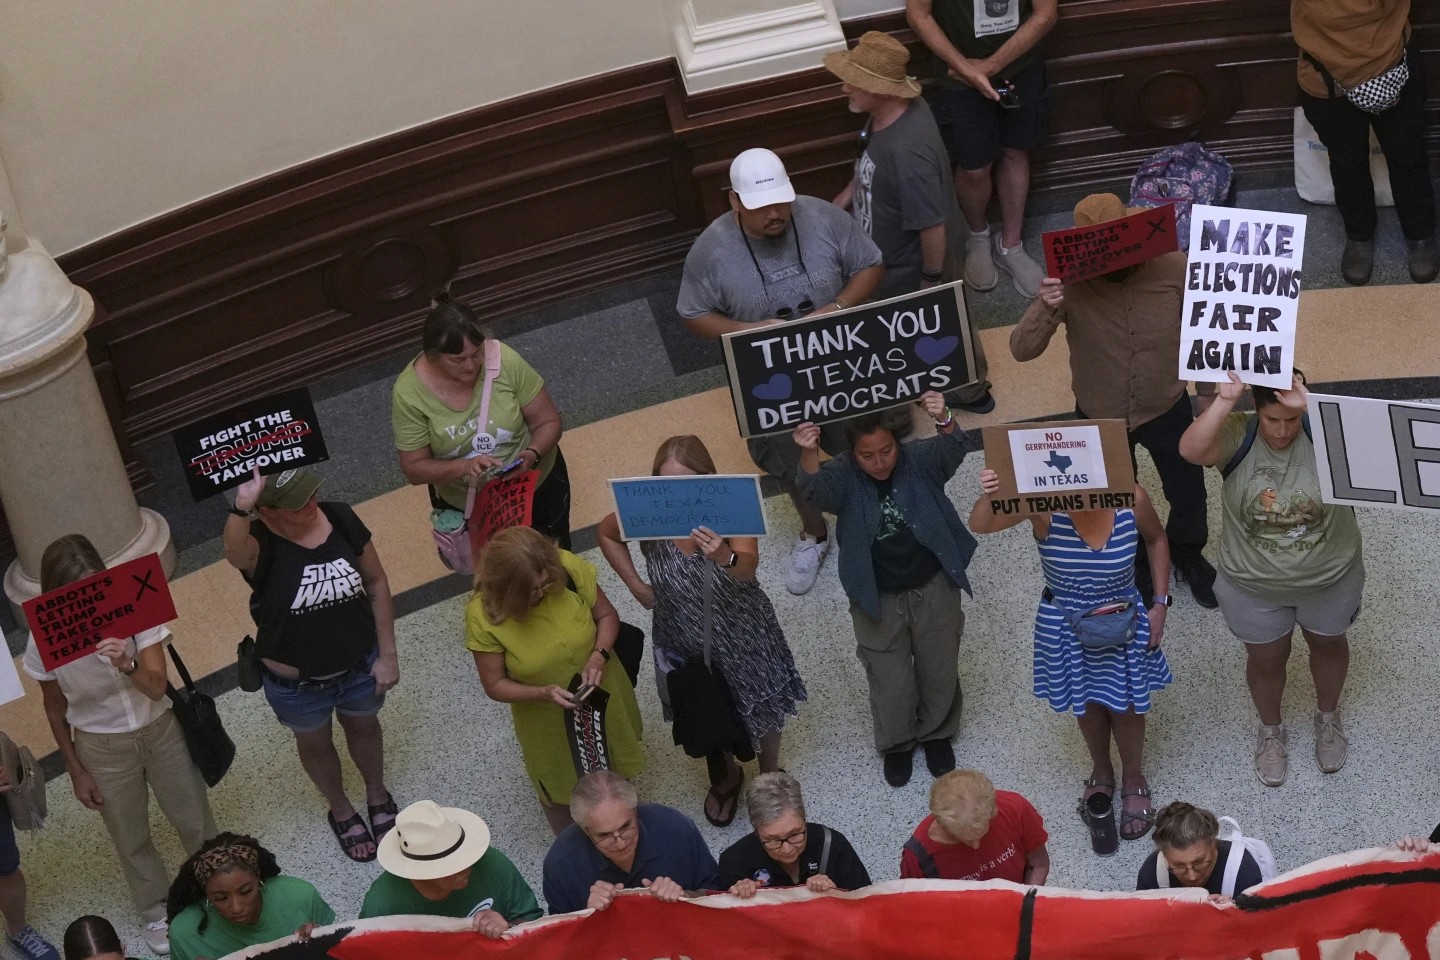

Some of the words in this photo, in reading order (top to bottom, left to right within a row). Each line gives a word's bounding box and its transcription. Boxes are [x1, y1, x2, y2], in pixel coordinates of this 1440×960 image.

[1200, 219, 1295, 259] MAKE
[1188, 262, 1301, 300] ELECTIONS
[1190, 301, 1282, 333] FAIR
[750, 320, 866, 369] THANK
[877, 304, 942, 343] YOU
[797, 348, 908, 391] TEXAS
[1187, 339, 1283, 375] AGAIN
[757, 365, 952, 430] DEMOCRATS
[199, 420, 252, 451] FIGHT
[254, 409, 293, 430] THE
[477, 436, 490, 444] NO
[1045, 432, 1063, 442] NO
[191, 420, 310, 476] TRUMP
[476, 443, 493, 451] ICE
[1025, 440, 1087, 452] GERRYMANDERING
[209, 446, 306, 486] TAKEOVER
[1034, 476, 1047, 487] IN
[1050, 473, 1089, 487] TEXAS
[622, 485, 672, 497] THANK
[695, 484, 732, 496] YOU
[651, 499, 715, 509] TEXAS
[991, 496, 1022, 515] PUT
[1026, 494, 1085, 513] TEXANS
[1090, 492, 1136, 511] FIRST!
[300, 557, 357, 587] STAR
[290, 571, 367, 611] WARS
[37, 591, 105, 626] LETTING
[41, 606, 97, 635] TRUMP
[290, 607, 305, 617] THE
[44, 622, 89, 647] TAKE
[90, 603, 135, 628] OVER
[50, 634, 103, 662] TEXAS
[979, 863, 987, 872] is
[997, 844, 1016, 865] verb!
